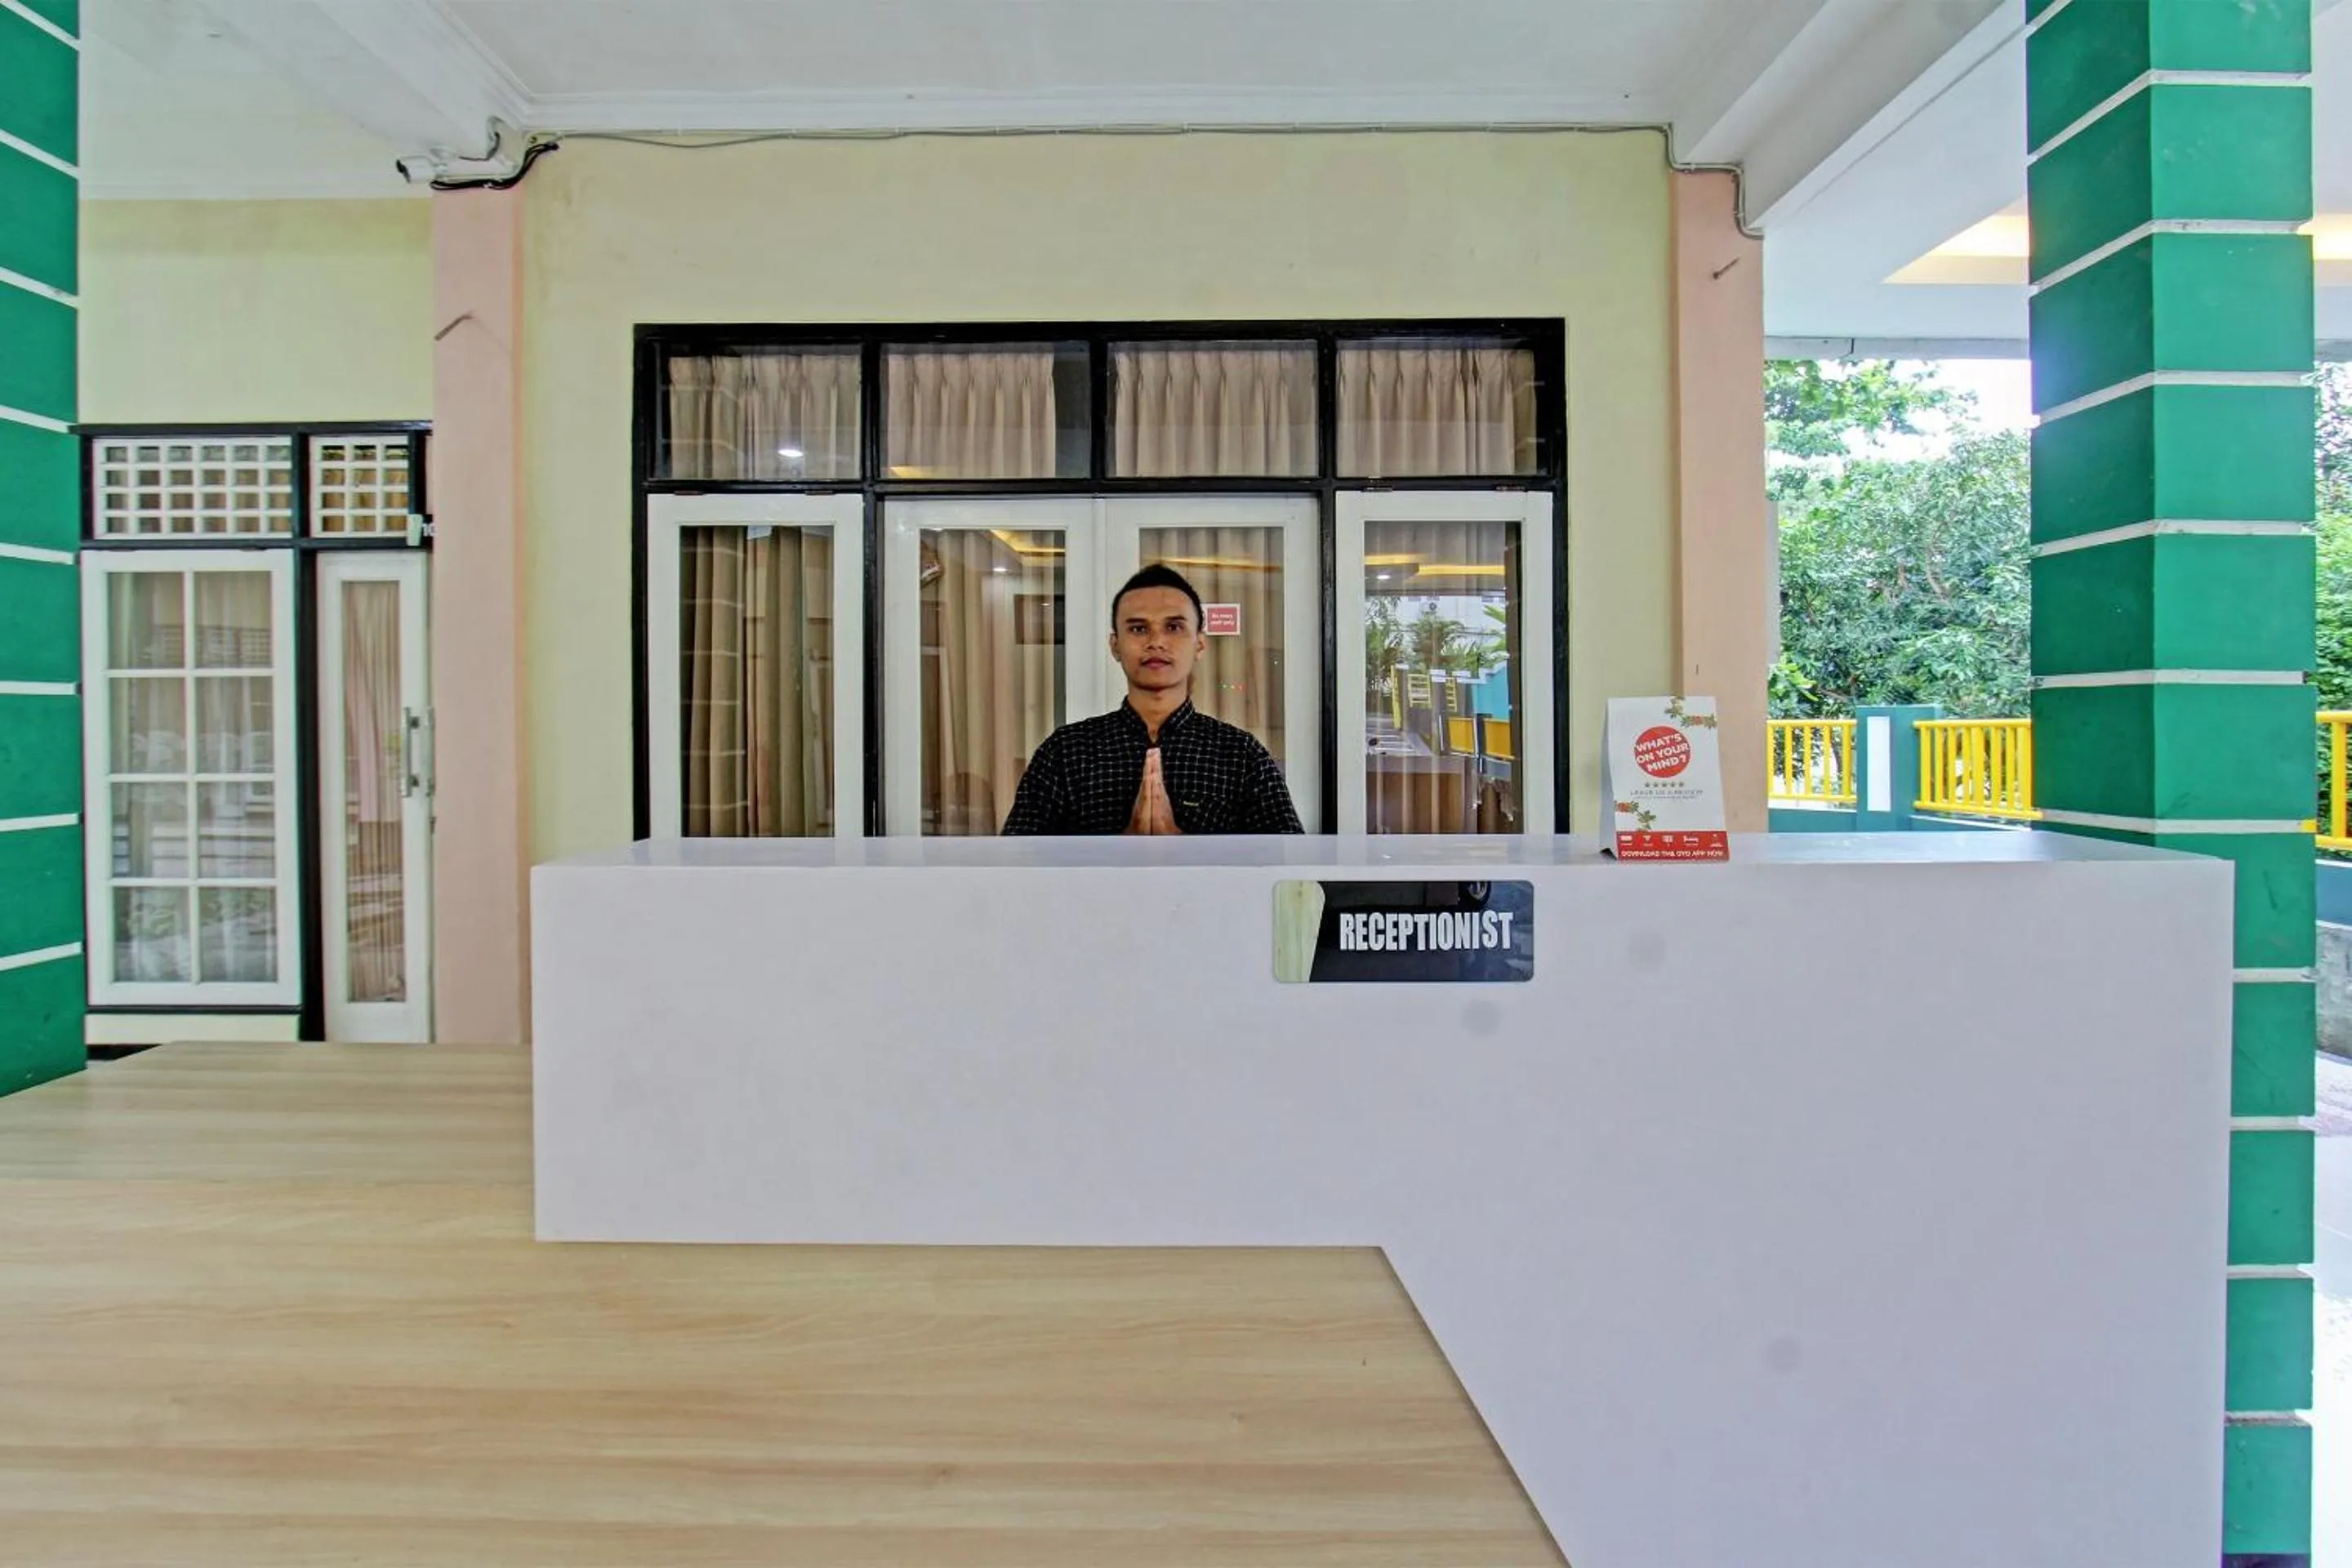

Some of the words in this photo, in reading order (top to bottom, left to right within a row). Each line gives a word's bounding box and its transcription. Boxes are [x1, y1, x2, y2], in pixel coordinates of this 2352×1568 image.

[1637, 733, 1682, 751] WHAT'S
[1637, 752, 1655, 764] ON
[1655, 743, 1689, 758] YOUR
[1339, 911, 1513, 951] RECEPTIONIST
